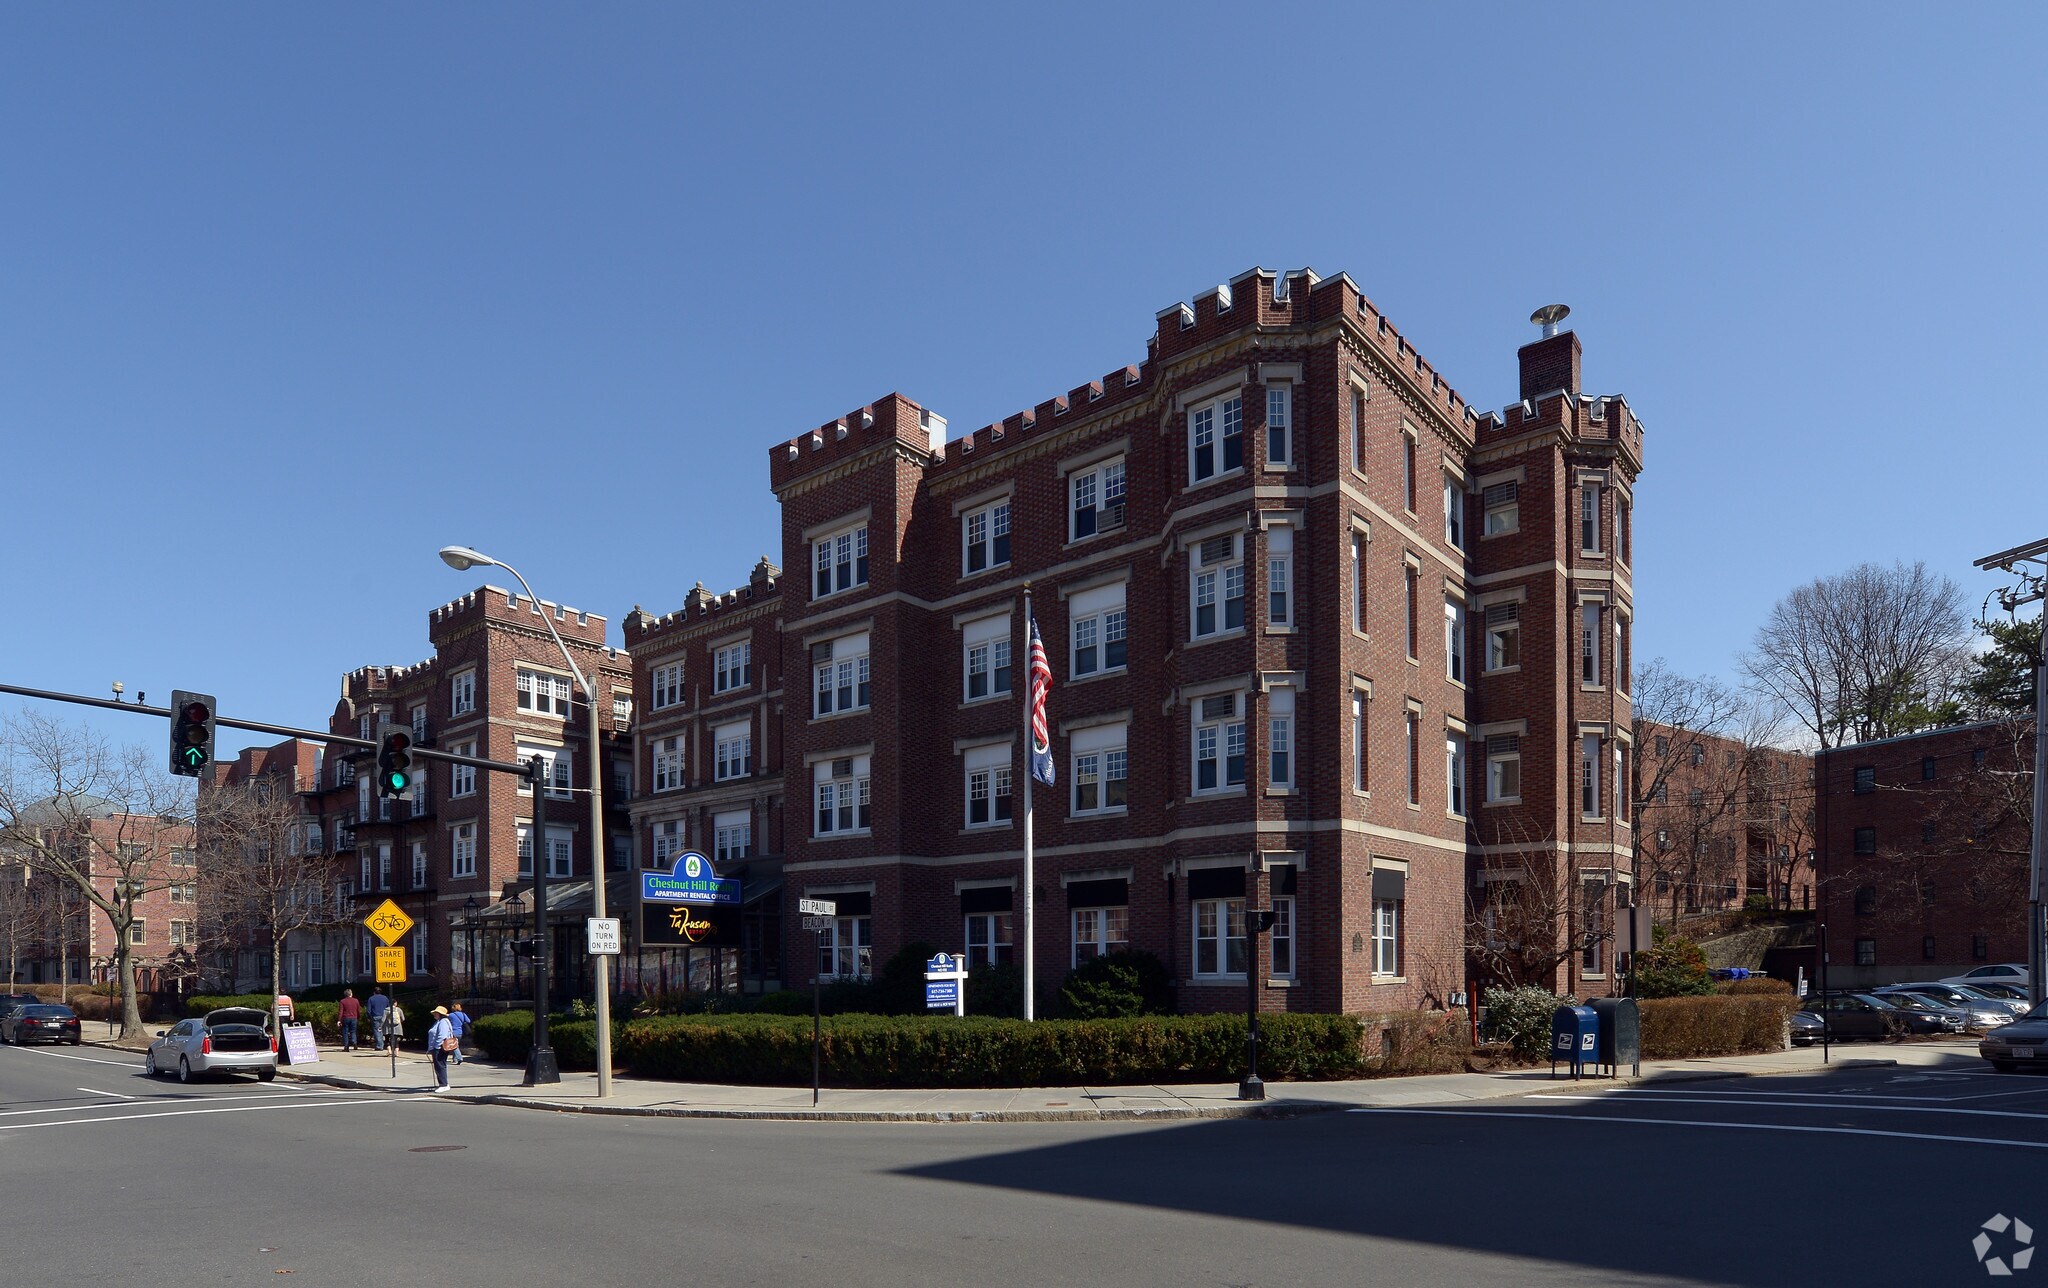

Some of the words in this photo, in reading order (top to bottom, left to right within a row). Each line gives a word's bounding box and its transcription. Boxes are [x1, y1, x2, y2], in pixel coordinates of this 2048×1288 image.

[649, 877, 689, 890] Chestnut
[691, 880, 707, 891] Hill
[709, 881, 735, 893] Realty
[654, 890, 689, 899] APARTMENT
[690, 891, 711, 900] RENTAL
[711, 893, 731, 901] OFFICE
[801, 900, 809, 911] ST
[811, 901, 827, 913] PAUL
[804, 917, 825, 928] BEACON
[595, 932, 613, 940] TURN
[603, 942, 617, 950] RED
[384, 960, 397, 968] THE
[381, 971, 401, 979] ROAD
